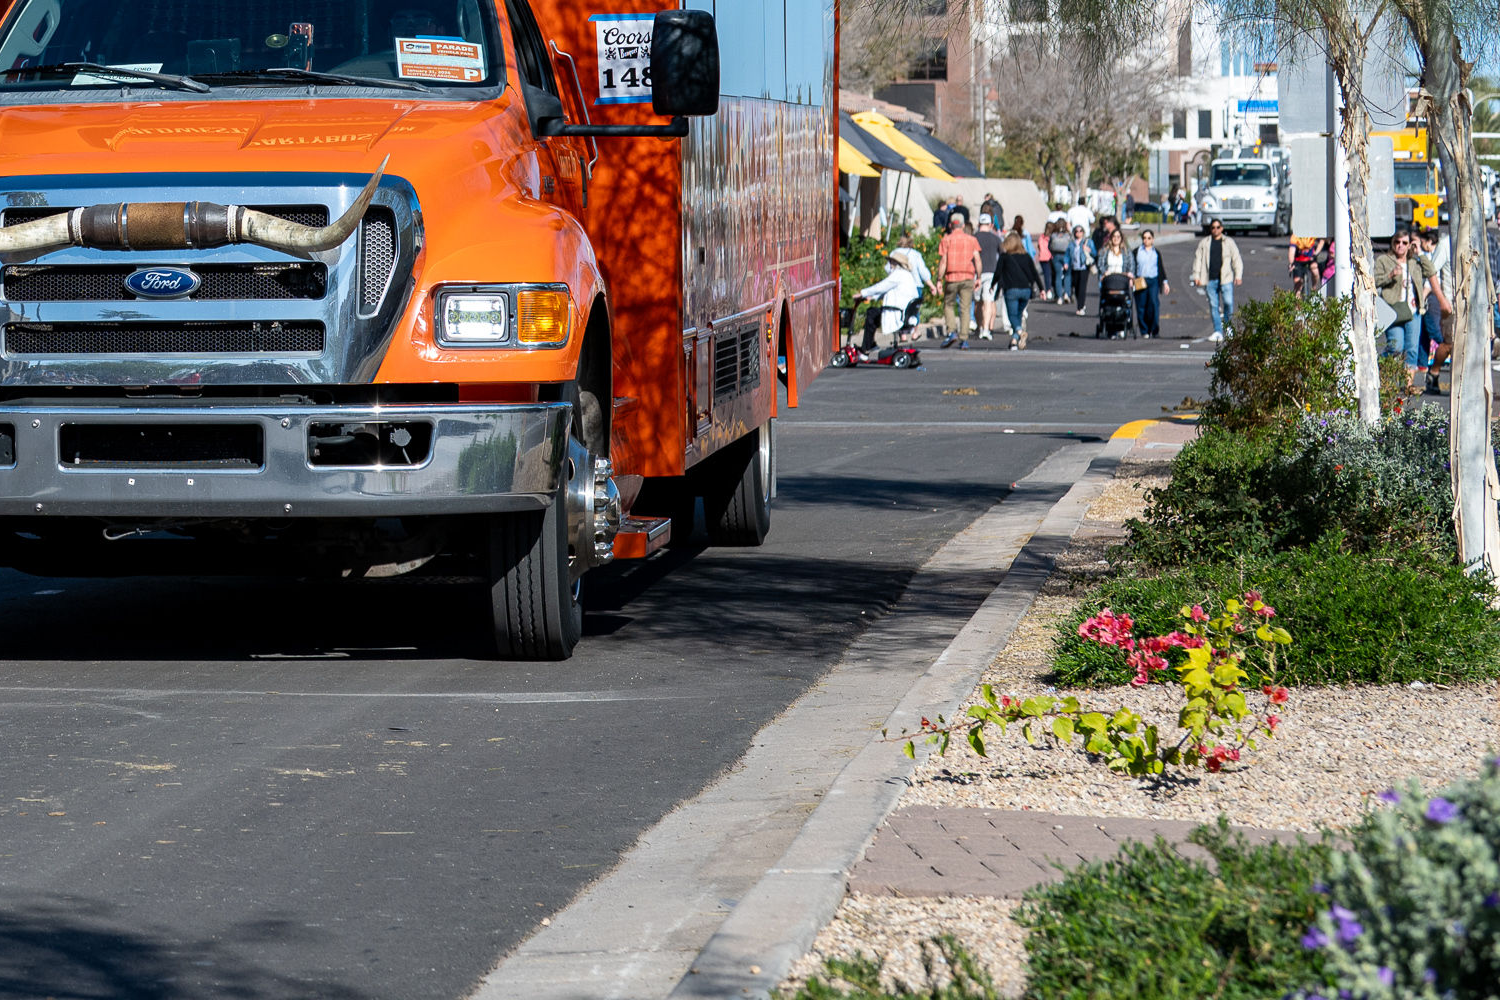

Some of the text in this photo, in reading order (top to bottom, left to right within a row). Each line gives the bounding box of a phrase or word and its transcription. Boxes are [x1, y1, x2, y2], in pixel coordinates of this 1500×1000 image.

[602, 27, 653, 46] Coors
[436, 44, 474, 52] PARADE
[463, 68, 479, 80] P
[602, 67, 653, 89] 148
[140, 271, 183, 290] Ford
